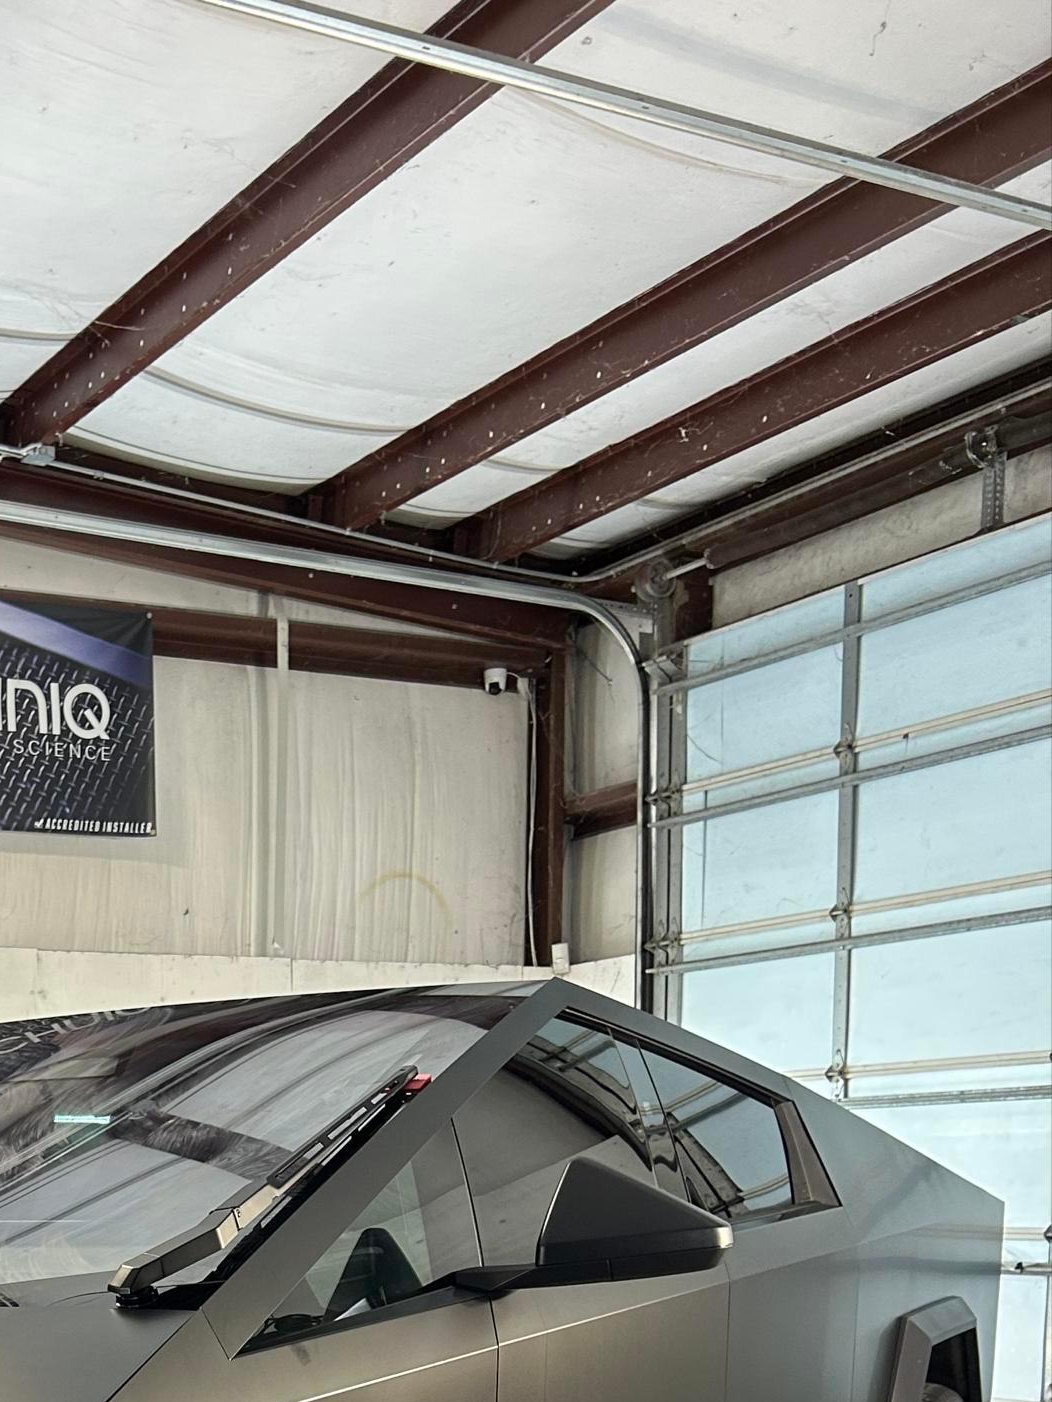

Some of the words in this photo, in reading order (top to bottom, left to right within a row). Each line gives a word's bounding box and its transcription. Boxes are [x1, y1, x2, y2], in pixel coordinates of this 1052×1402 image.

[13, 738, 112, 762] SCIENCE
[45, 817, 102, 833] ACCREDITED
[102, 820, 153, 835] INSTALLER
